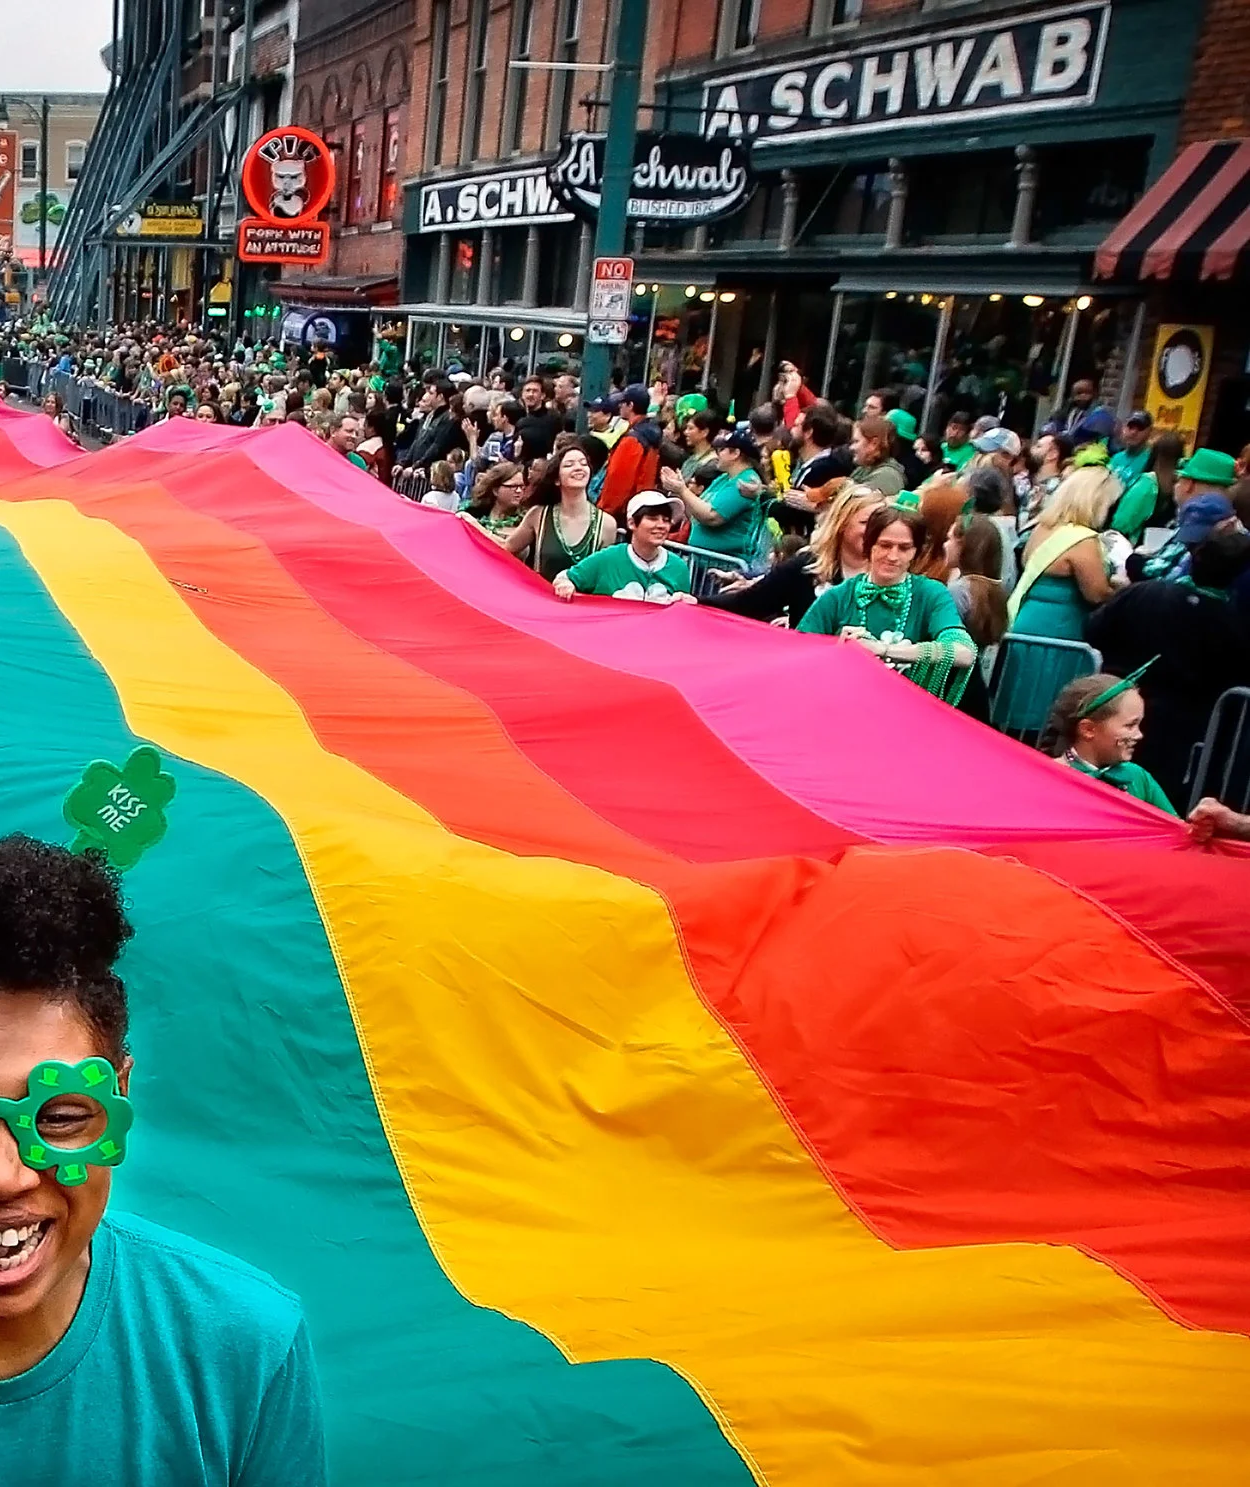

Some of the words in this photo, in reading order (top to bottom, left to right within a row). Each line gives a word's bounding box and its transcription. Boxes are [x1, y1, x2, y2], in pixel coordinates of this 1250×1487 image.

[1, 137, 9, 146] a
[258, 135, 322, 163] PIG
[632, 145, 748, 193] chwab
[629, 200, 687, 215] BLISHED
[246, 228, 284, 239] PORK
[288, 229, 321, 240] WITH
[245, 241, 262, 253] AN
[264, 242, 321, 254] ATTITUDE!
[602, 262, 626, 277] NO
[108, 783, 148, 817] KISS
[97, 804, 130, 832] ME
